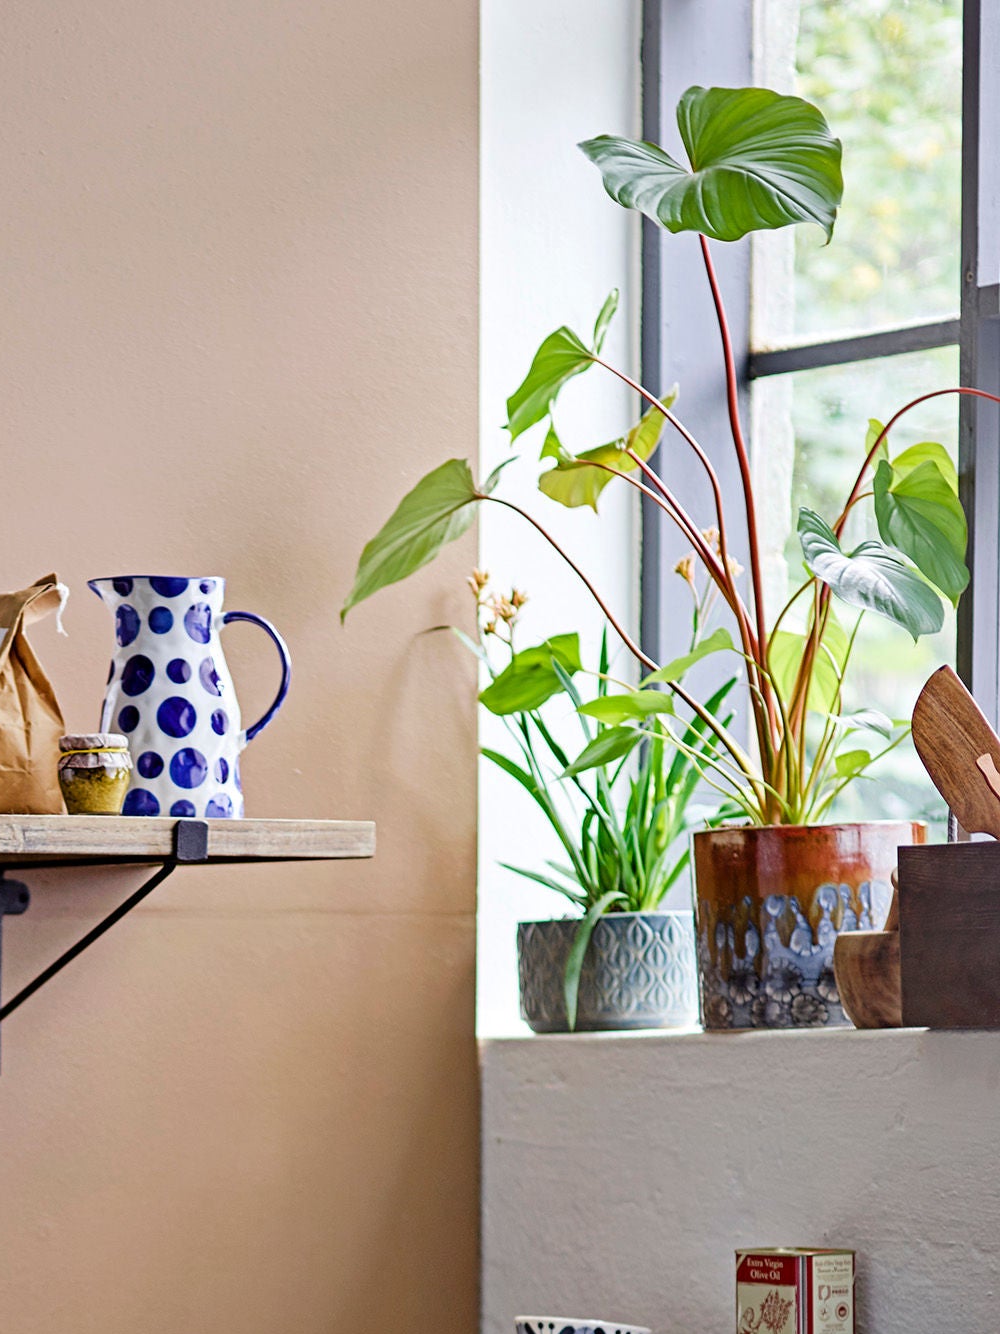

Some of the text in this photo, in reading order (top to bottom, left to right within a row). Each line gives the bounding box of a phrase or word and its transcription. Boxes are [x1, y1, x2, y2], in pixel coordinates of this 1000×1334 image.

[747, 1257, 784, 1270] Extra Virgin
[750, 1269, 781, 1281] Olive Oil
